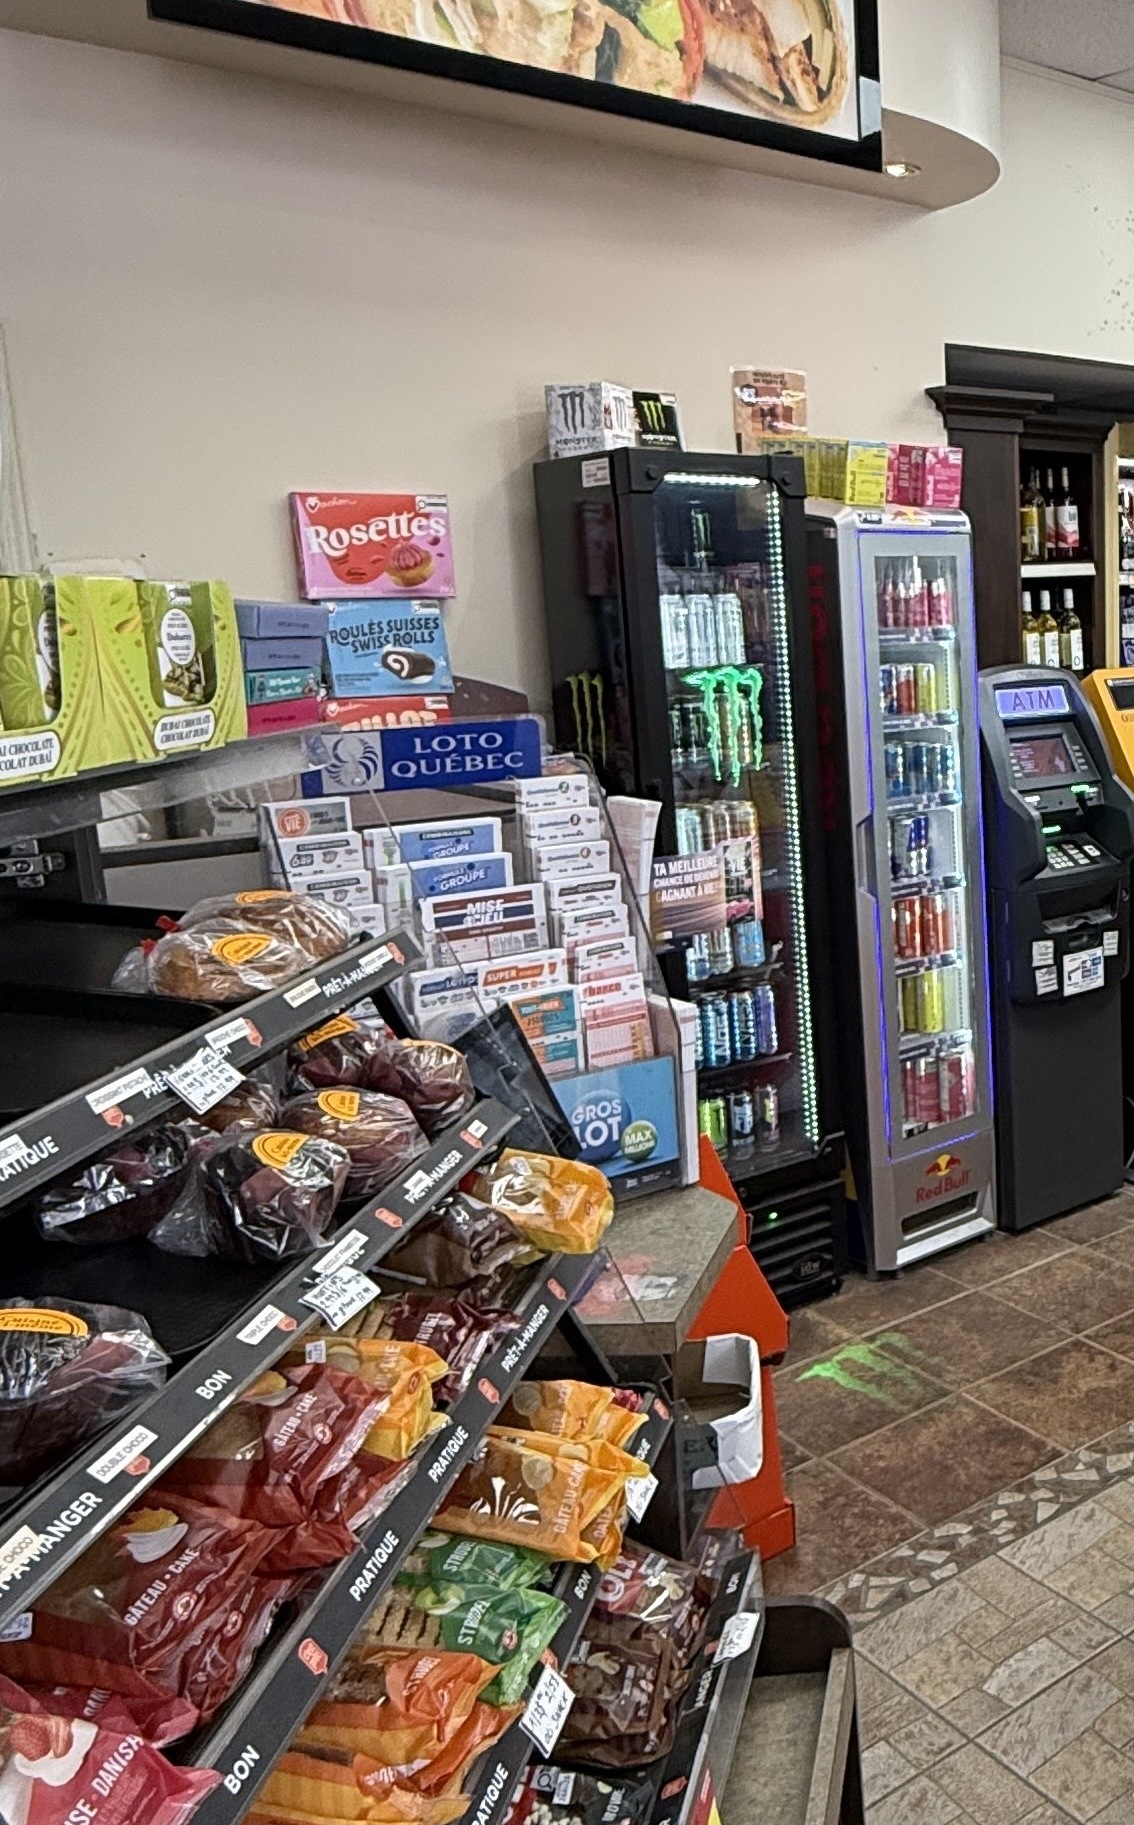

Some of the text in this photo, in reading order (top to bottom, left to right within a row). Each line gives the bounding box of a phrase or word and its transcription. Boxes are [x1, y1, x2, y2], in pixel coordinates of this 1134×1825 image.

[556, 437, 599, 446] MONSTER
[307, 511, 446, 557] Rosettes
[329, 616, 440, 646] ROULÉS SUISSES
[350, 631, 436, 653] SWISS ROLLS
[1011, 689, 1056, 712] ATM
[180, 714, 211, 729] CHOCOLATE
[8, 738, 54, 756] CHOCOLATE
[413, 731, 503, 756] LOTO
[0, 754, 27, 771] COLAT
[391, 752, 525, 780] QUÉBEC
[440, 870, 487, 891] GROUPE
[654, 863, 667, 877] TA
[486, 969, 517, 983] SUPER
[571, 1099, 623, 1124] GROS
[579, 1115, 623, 1149] LOT
[623, 1129, 652, 1146] MAX
[0, 1136, 60, 1181] ATIQUE
[916, 1170, 970, 1204] Red Bull
[501, 1304, 550, 1373] PRÊT-À-MANGER
[196, 1369, 233, 1400] BON
[272, 1414, 298, 1448] GÂTEAU
[96, 1432, 149, 1477] DOUBLE CHOCO
[428, 1425, 469, 1484] PRATIQUE
[0, 1491, 104, 1596] -À-MANGER
[4, 1535, 34, 1564] CHOCO
[349, 1530, 400, 1602] PRATIQUE
[124, 1547, 200, 1626] GÂTEAU CAKE
[573, 1569, 592, 1600] BON
[91, 1734, 144, 1797] DANISH
[224, 1744, 261, 1795] BON
[471, 1762, 510, 1825] RATIQUE
